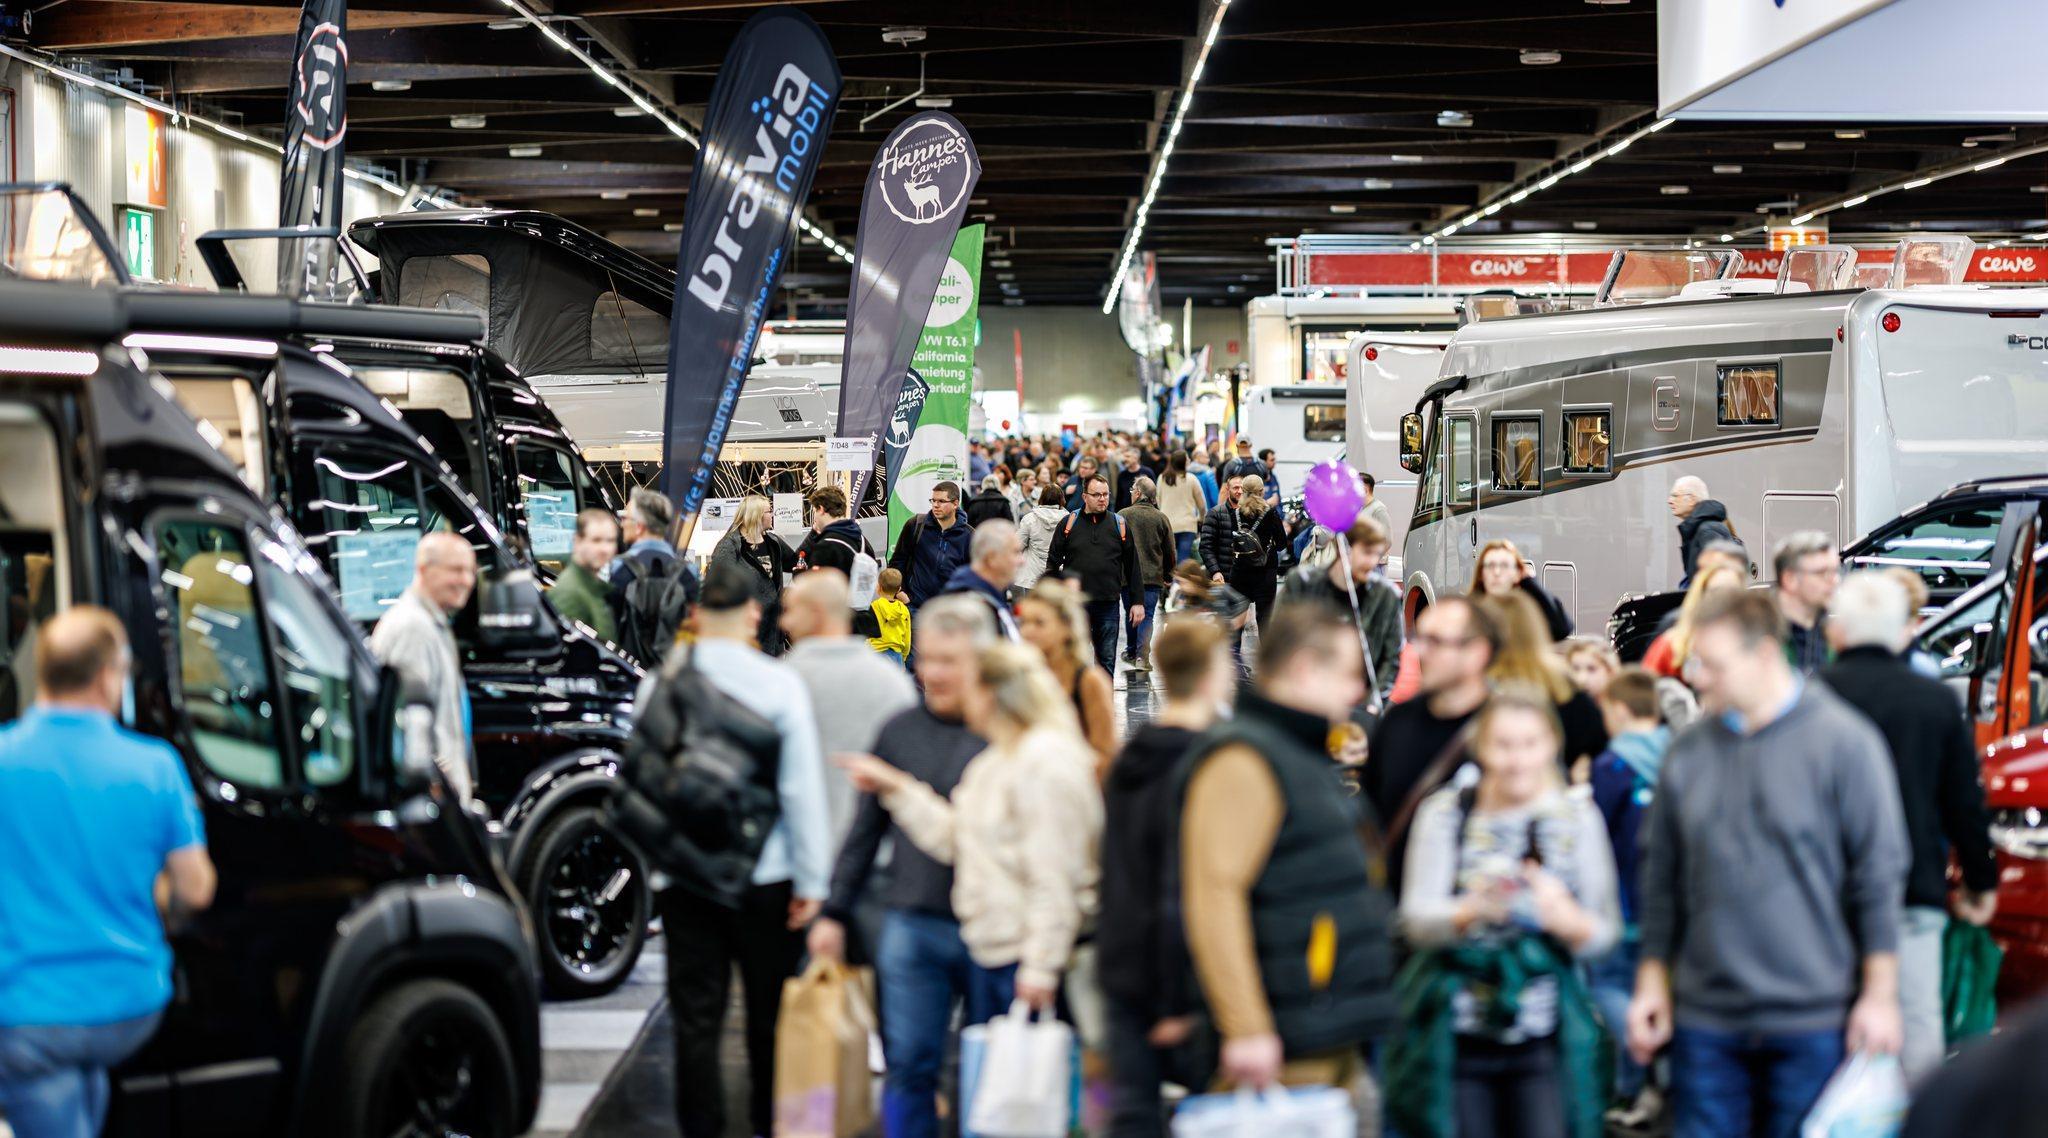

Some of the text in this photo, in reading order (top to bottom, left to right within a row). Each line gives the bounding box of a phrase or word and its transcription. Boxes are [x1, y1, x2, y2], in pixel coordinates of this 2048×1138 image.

[775, 80, 830, 193] mobil
[877, 136, 967, 180] Hannes
[910, 154, 958, 178] Camper
[687, 62, 811, 313] bravia
[1469, 257, 1528, 277] cewe
[1979, 256, 2037, 273] cewe
[939, 274, 962, 288] ali-
[749, 286, 768, 319] the
[923, 335, 967, 347] VW T6.1
